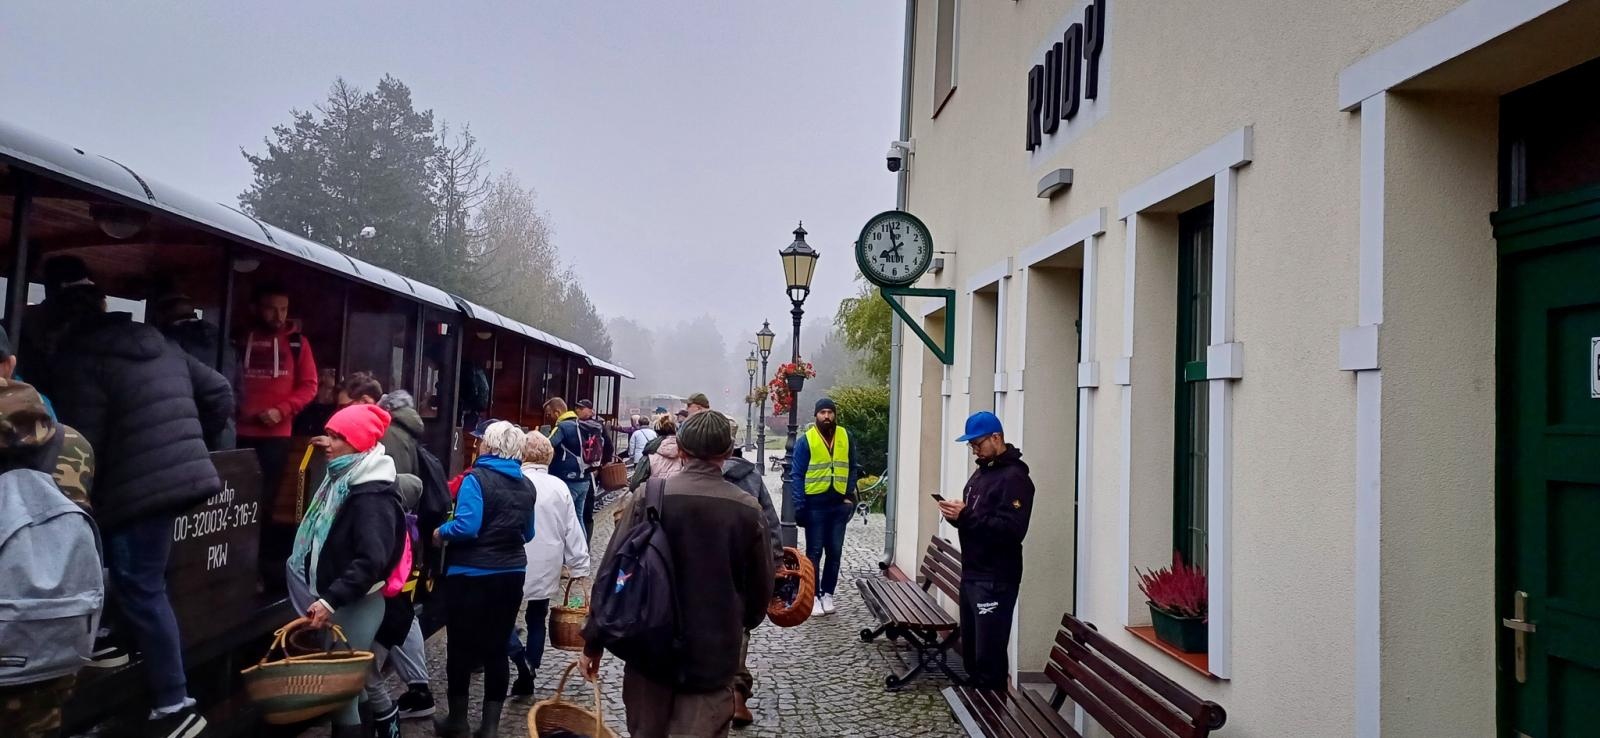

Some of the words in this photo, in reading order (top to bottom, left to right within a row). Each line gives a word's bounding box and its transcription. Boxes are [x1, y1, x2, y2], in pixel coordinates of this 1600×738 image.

[1026, 0, 1106, 151] RUDY
[881, 224, 889, 233] 11
[892, 222, 901, 230] 12
[906, 226, 910, 234] 1
[873, 232, 882, 241] 10
[913, 233, 919, 242] 2
[868, 243, 873, 252] 9
[917, 246, 922, 255] 3
[872, 256, 878, 264] 8
[912, 256, 918, 265] 4
[880, 264, 885, 272] 7
[892, 267, 898, 276] 6
[904, 265, 910, 273] 5
[453, 431, 459, 451] 2
[173, 501, 258, 542] 00-320034-316-2
[207, 542, 228, 570] PKW
